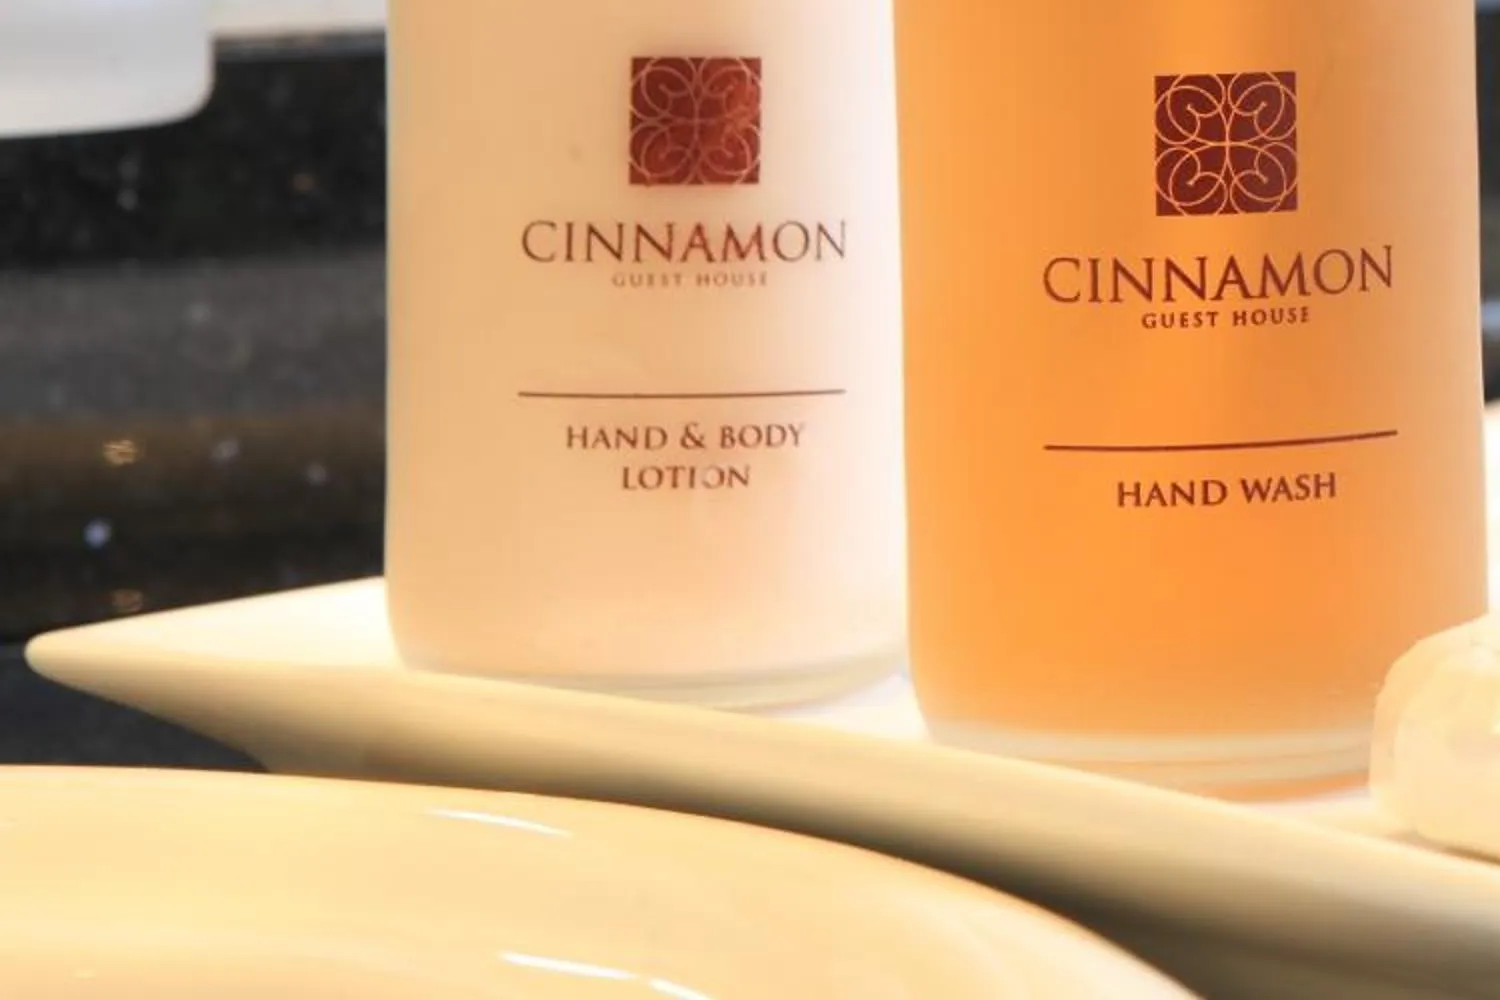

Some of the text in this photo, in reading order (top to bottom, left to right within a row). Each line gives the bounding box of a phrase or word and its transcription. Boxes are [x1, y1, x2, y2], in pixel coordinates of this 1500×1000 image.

[522, 219, 846, 263] CINNAMON
[611, 271, 768, 288] GUEST HOUSE
[1042, 245, 1393, 303] CINNAMON
[1141, 306, 1311, 330] GUEST HOUSE
[565, 422, 805, 450] HAND & BODY
[621, 465, 751, 490] LOTION
[1116, 472, 1337, 508] HAND WASH
